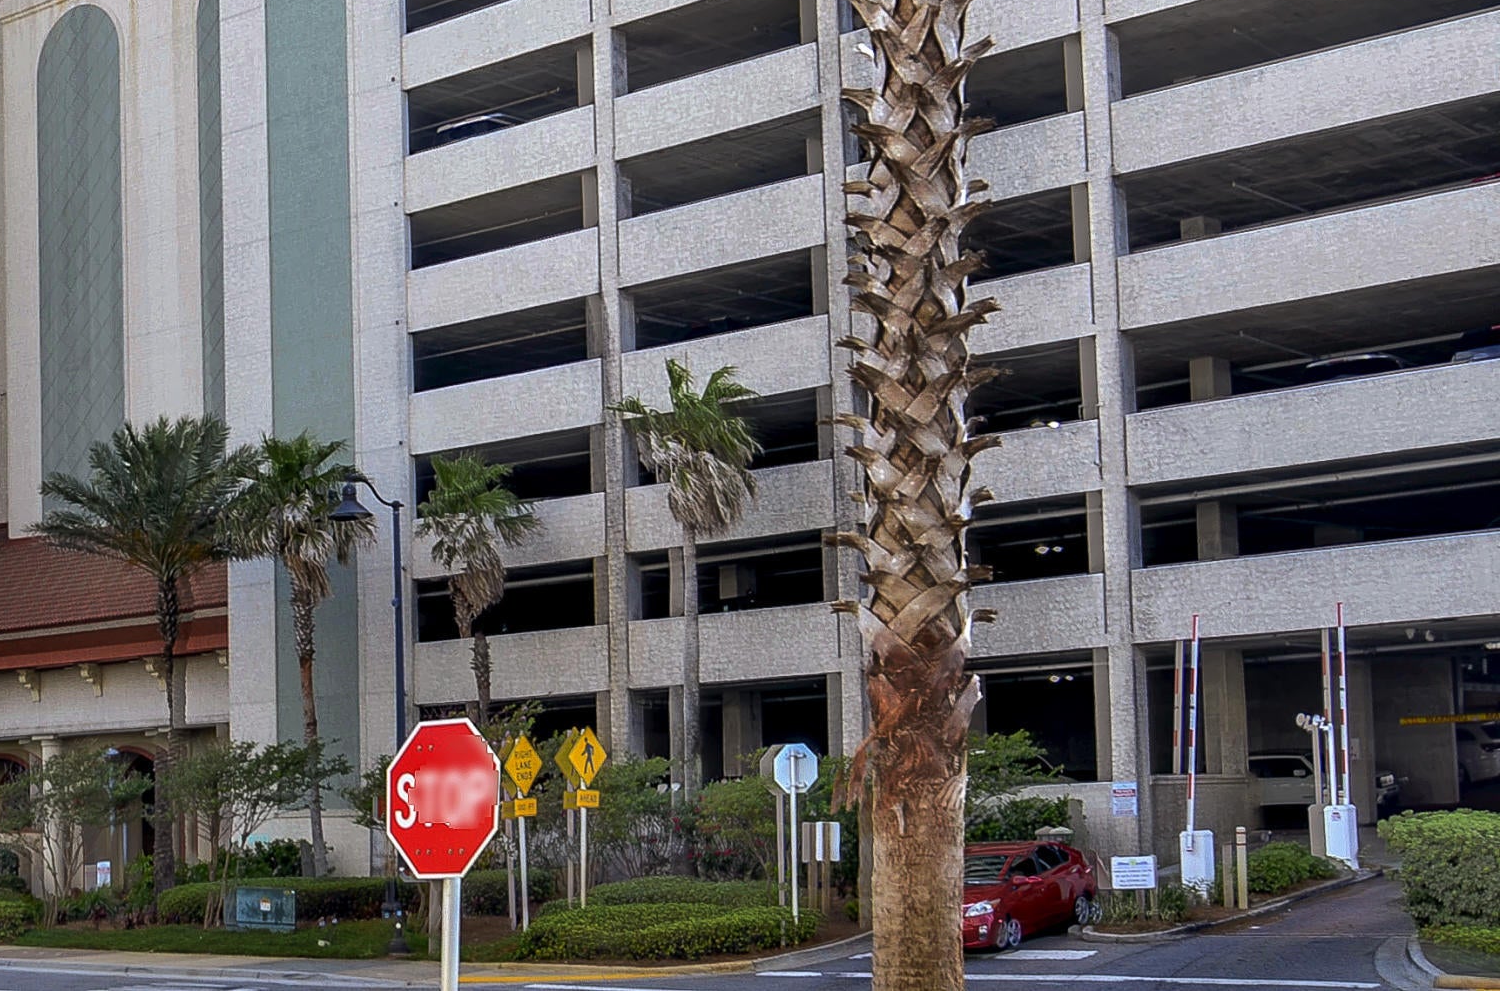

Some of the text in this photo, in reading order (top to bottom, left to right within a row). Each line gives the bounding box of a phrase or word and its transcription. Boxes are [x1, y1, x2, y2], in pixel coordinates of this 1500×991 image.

[515, 749, 532, 759] RIGHT
[516, 760, 532, 770] LANE
[516, 771, 532, 781] ENDS
[580, 794, 597, 803] AHEAD
